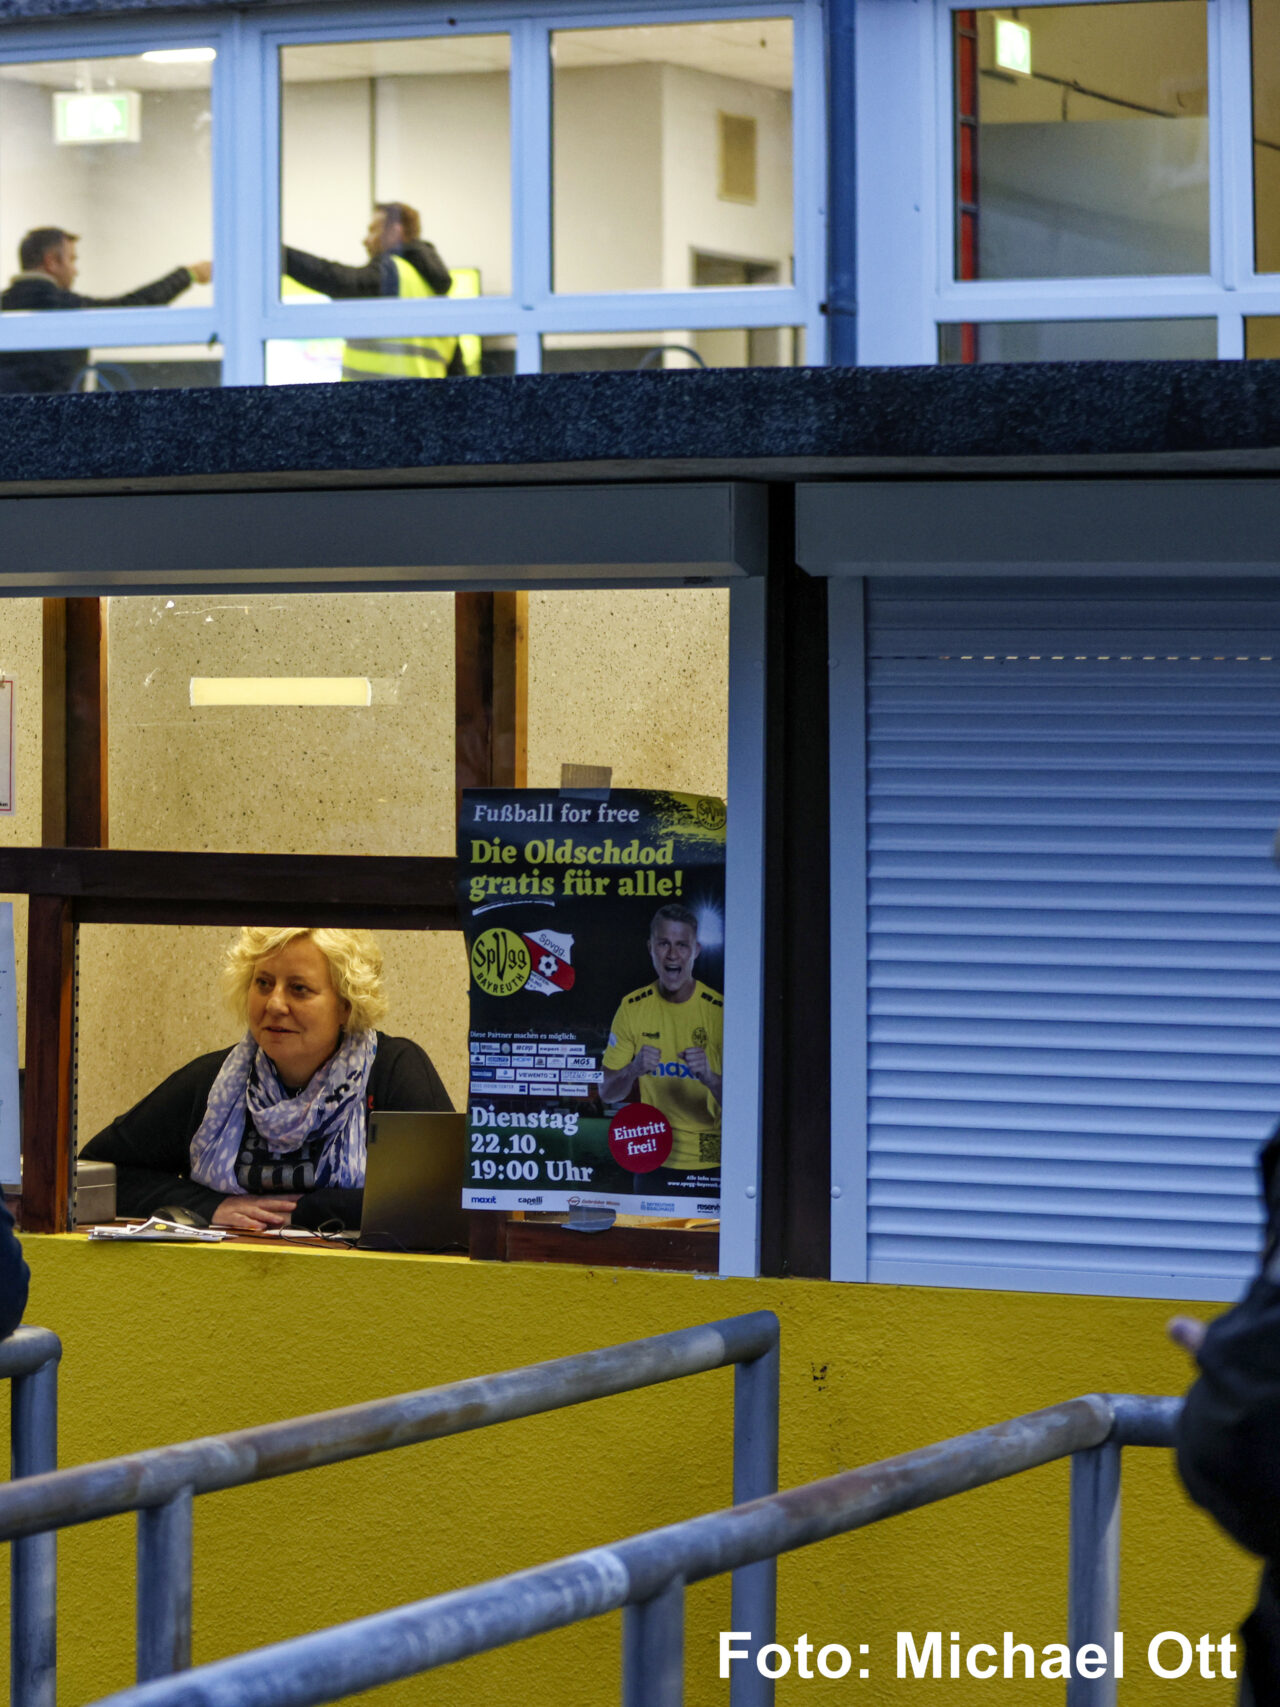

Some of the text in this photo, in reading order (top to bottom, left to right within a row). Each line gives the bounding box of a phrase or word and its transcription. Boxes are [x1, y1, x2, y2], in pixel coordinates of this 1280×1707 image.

[473, 803, 640, 823] Fußball for free
[470, 837, 674, 865] Die Oldschdod
[469, 868, 683, 902] gratis für alle!
[473, 931, 527, 981] SpVgg
[476, 973, 524, 993] BAYREUTH
[487, 1031, 512, 1039] Partner
[548, 1033, 577, 1041] möglich:
[471, 1104, 579, 1135] Dienstag
[613, 1121, 666, 1141] Eintritt
[471, 1133, 545, 1154] 22.10.
[627, 1138, 657, 1156] frei!
[471, 1159, 594, 1182] 19:00 Uhr
[471, 1195, 497, 1204] maxit
[518, 1196, 543, 1205] capelli
